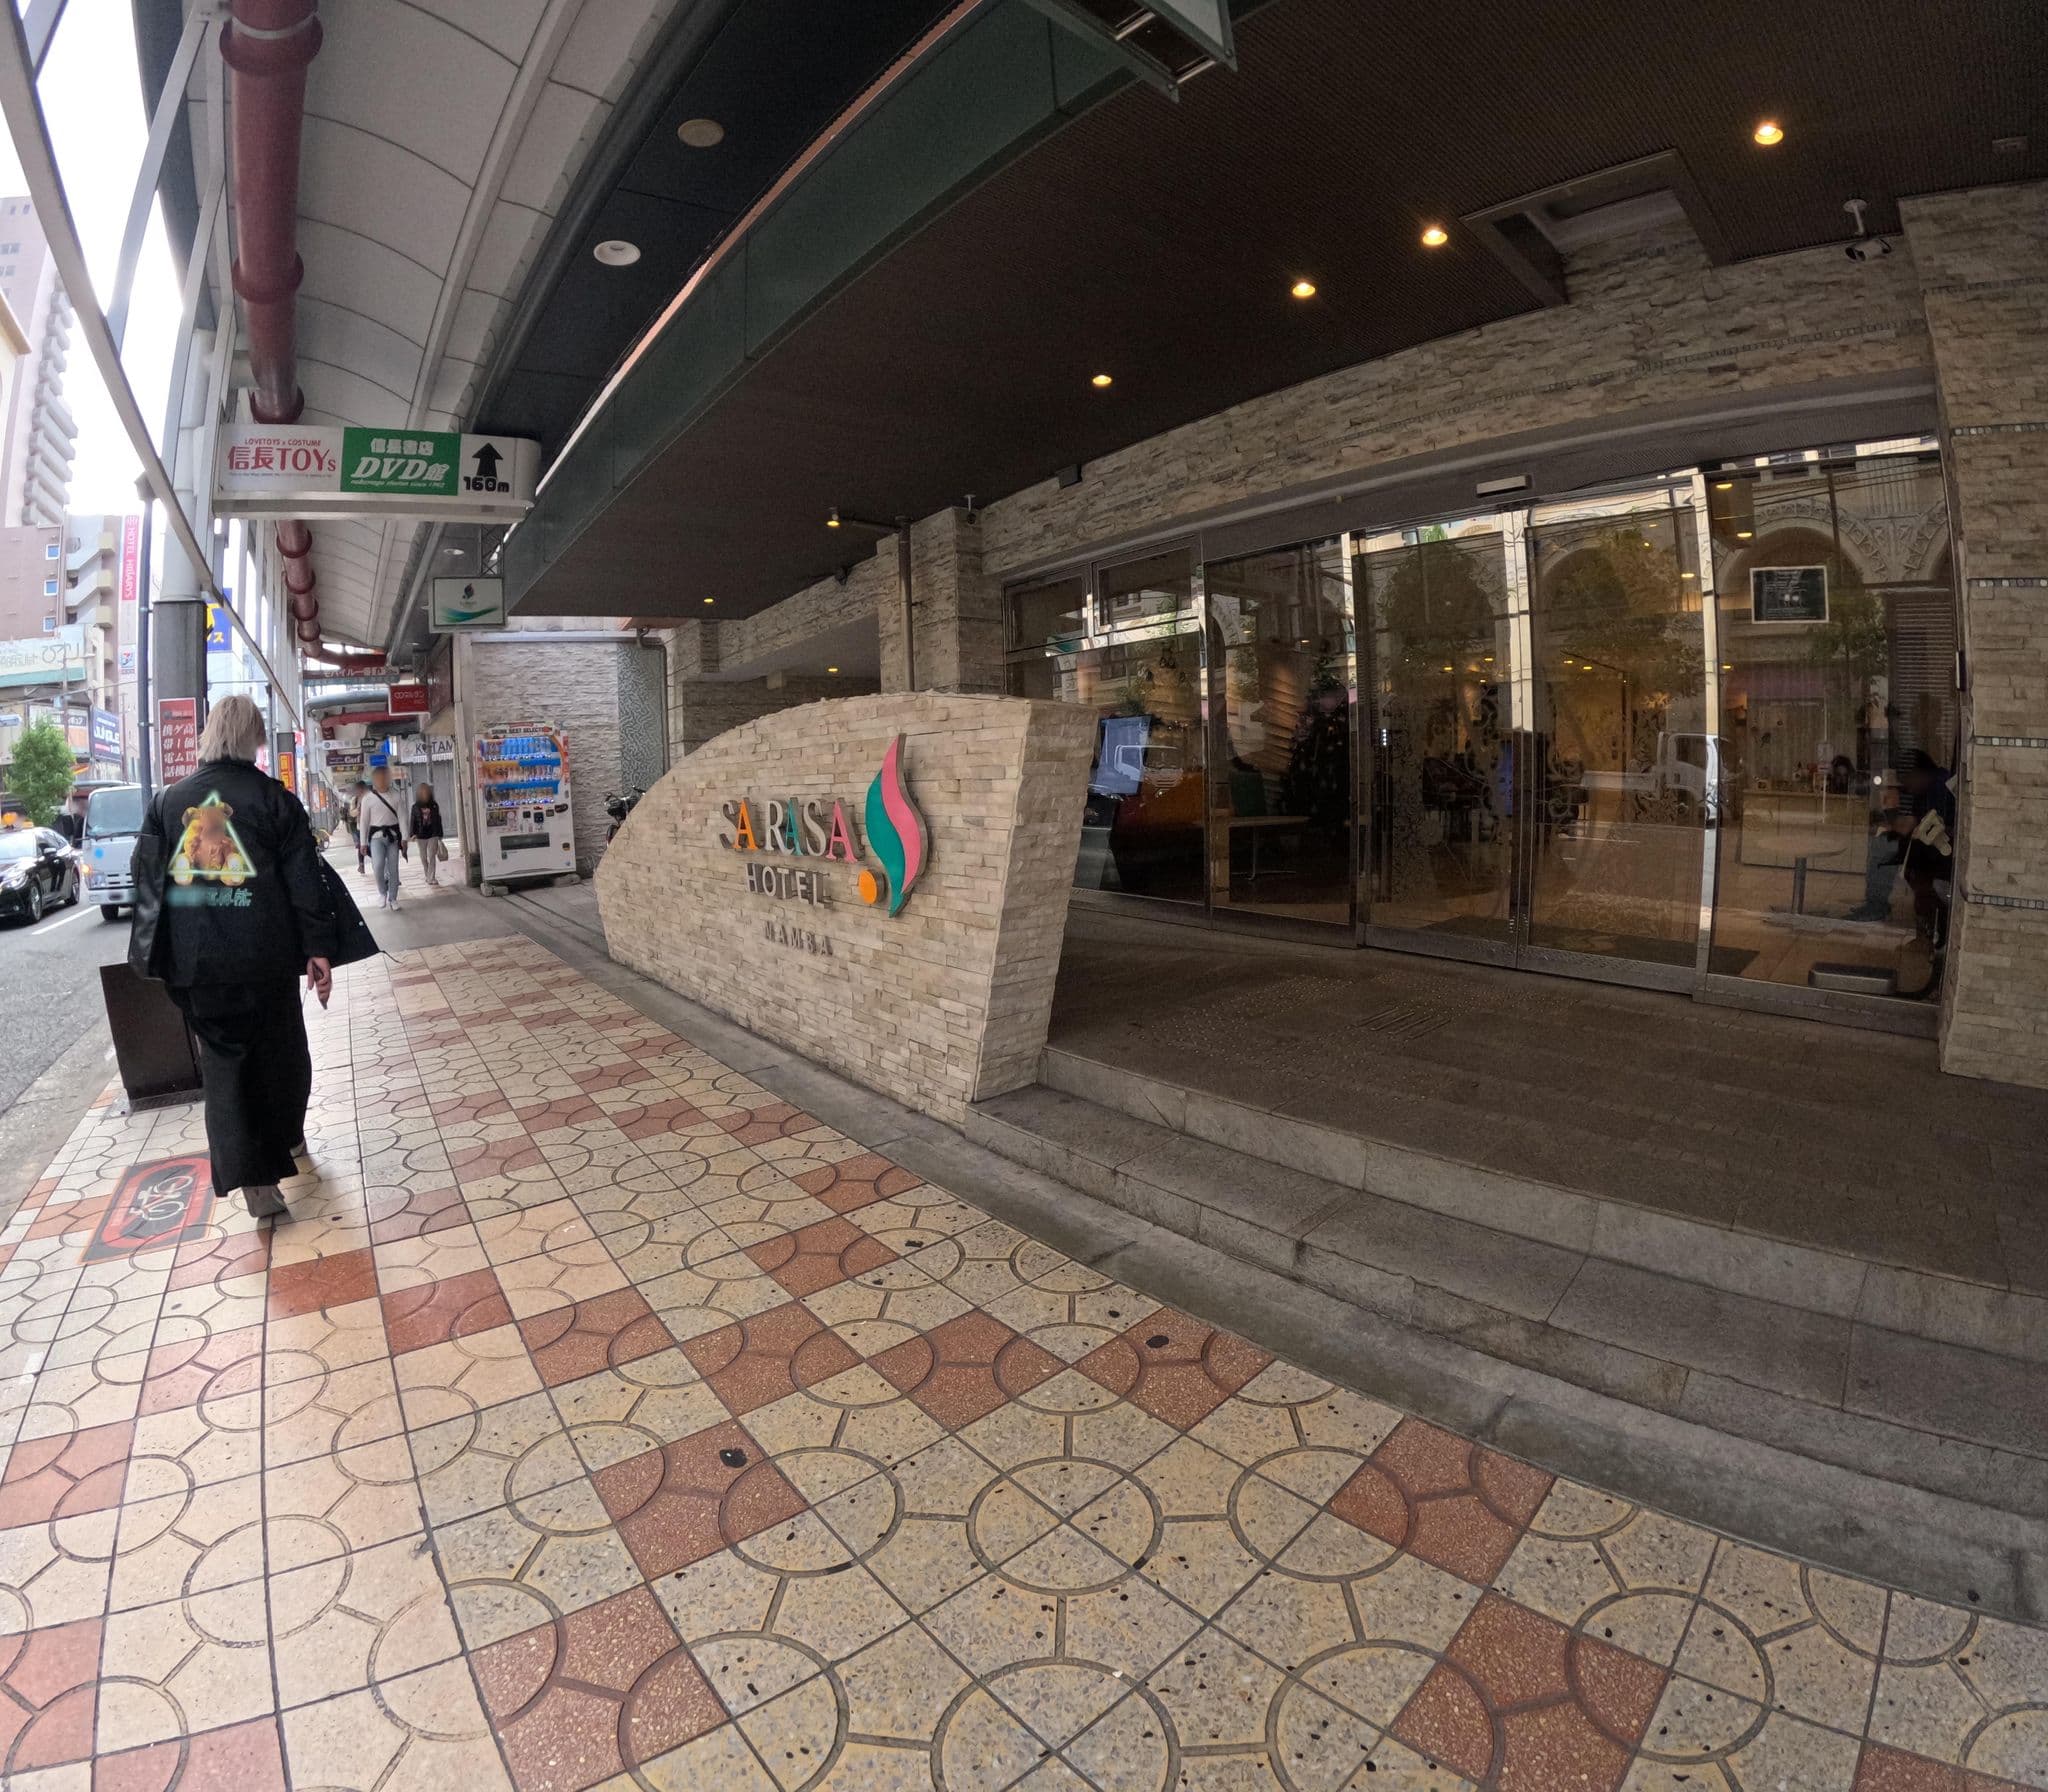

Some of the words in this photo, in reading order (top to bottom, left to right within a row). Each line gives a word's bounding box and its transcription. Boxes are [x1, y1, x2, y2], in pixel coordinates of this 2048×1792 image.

[244, 437, 281, 446] LOVETOYS
[288, 438, 321, 447] COSTUME
[228, 446, 336, 472] 信長TOYs
[350, 456, 450, 482] DVD館
[463, 475, 509, 493] 160m
[127, 527, 136, 557] HOTEL
[719, 798, 859, 864] SARASA
[745, 862, 826, 909] HOTEL
[764, 920, 834, 956] NAMBA
